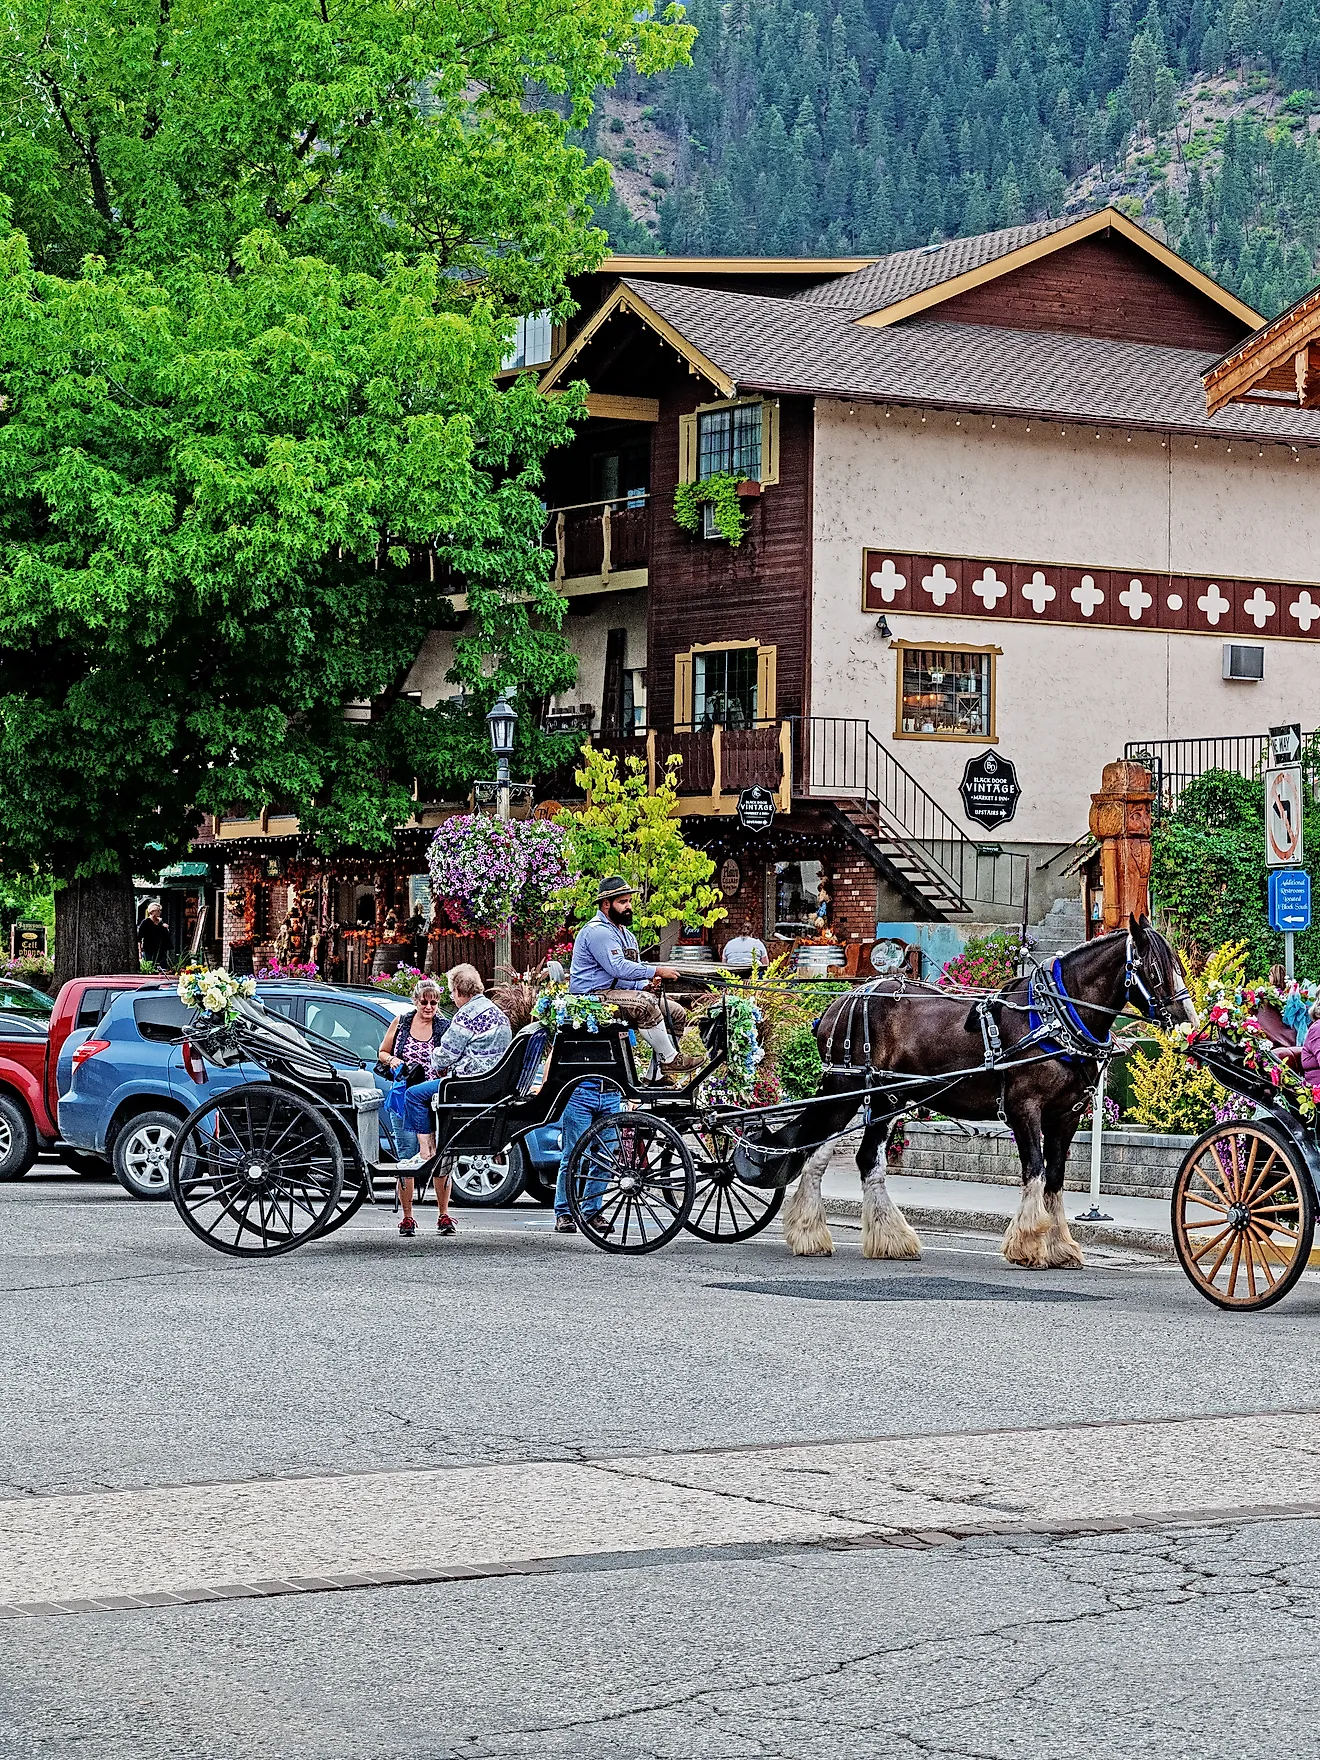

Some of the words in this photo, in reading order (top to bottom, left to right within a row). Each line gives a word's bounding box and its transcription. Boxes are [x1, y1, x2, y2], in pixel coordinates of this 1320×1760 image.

[966, 783, 1015, 794] VINTAGE
[1280, 879, 1306, 887] Additional
[1294, 902, 1308, 910] South
